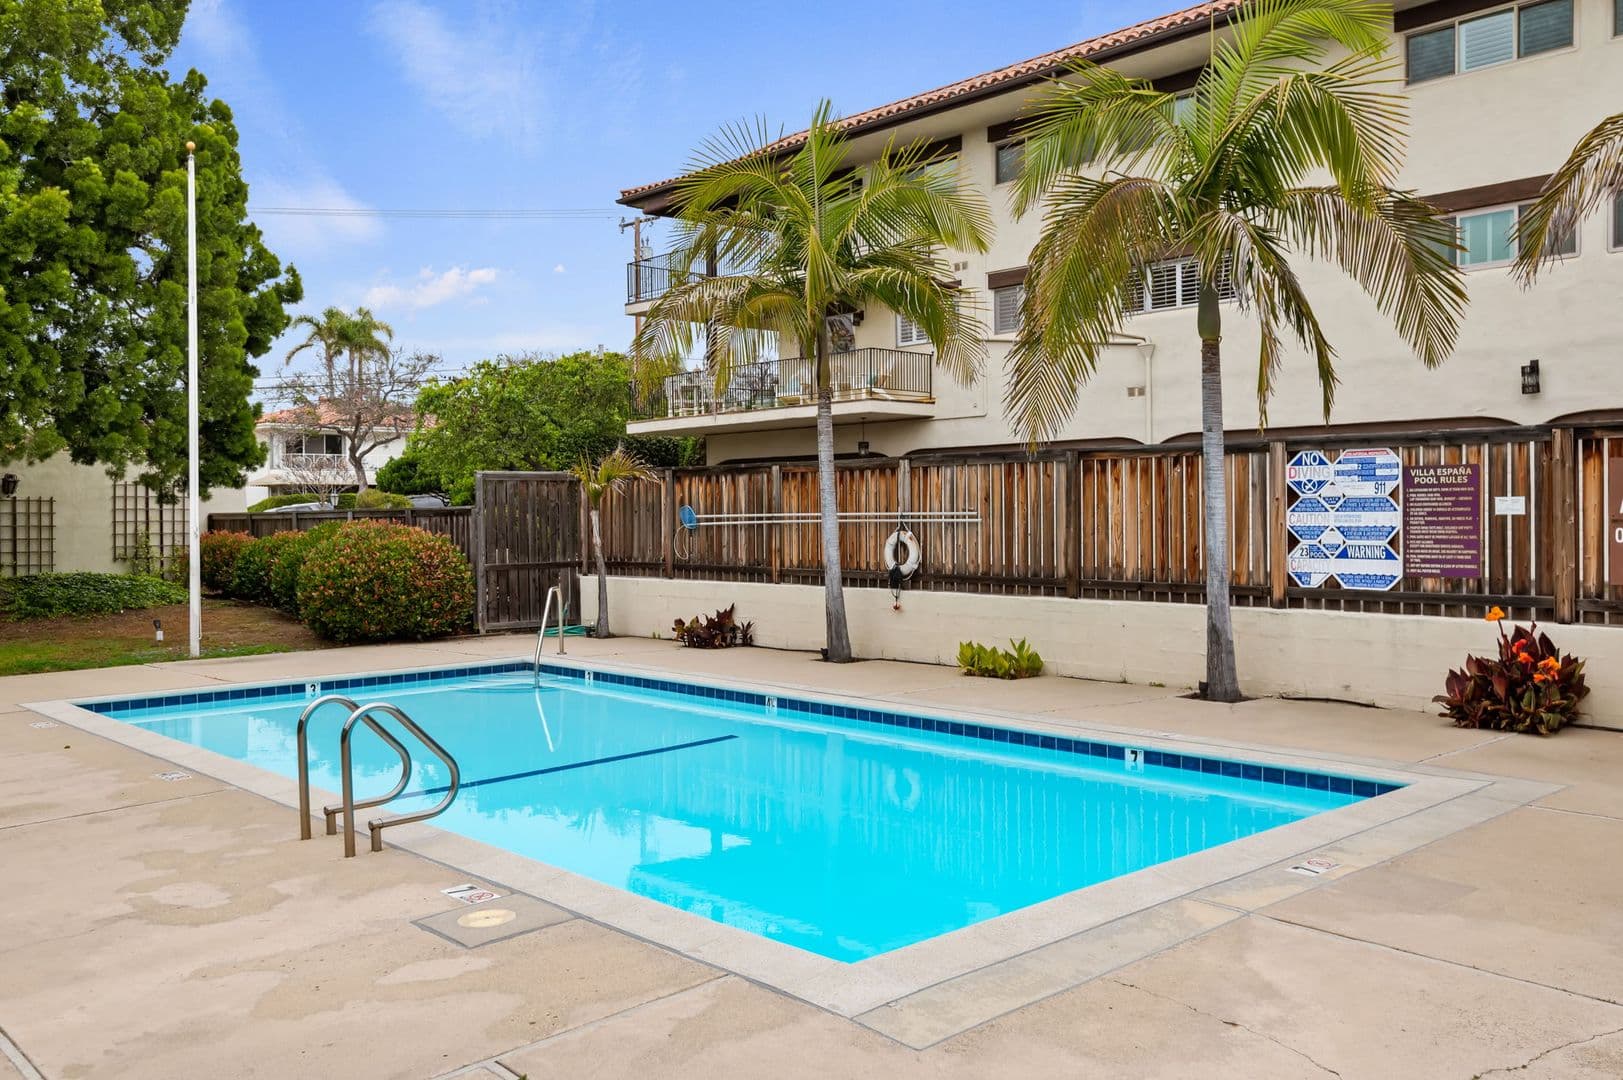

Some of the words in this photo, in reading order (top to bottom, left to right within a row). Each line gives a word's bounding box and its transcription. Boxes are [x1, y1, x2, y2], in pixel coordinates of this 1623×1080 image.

[1302, 452, 1319, 466] NO
[1288, 467, 1330, 479] DIVING
[1410, 468, 1435, 477] VILLA
[1436, 466, 1472, 476] ESPAÑA
[1414, 476, 1438, 484] POOL
[1440, 475, 1468, 484] RULES
[1374, 481, 1386, 495] 911
[1289, 513, 1330, 525] CAUTION
[1300, 547, 1309, 557] 23
[1310, 551, 1326, 559] POOL
[1346, 544, 1386, 559] WARNING
[1130, 749, 1138, 762] 7
